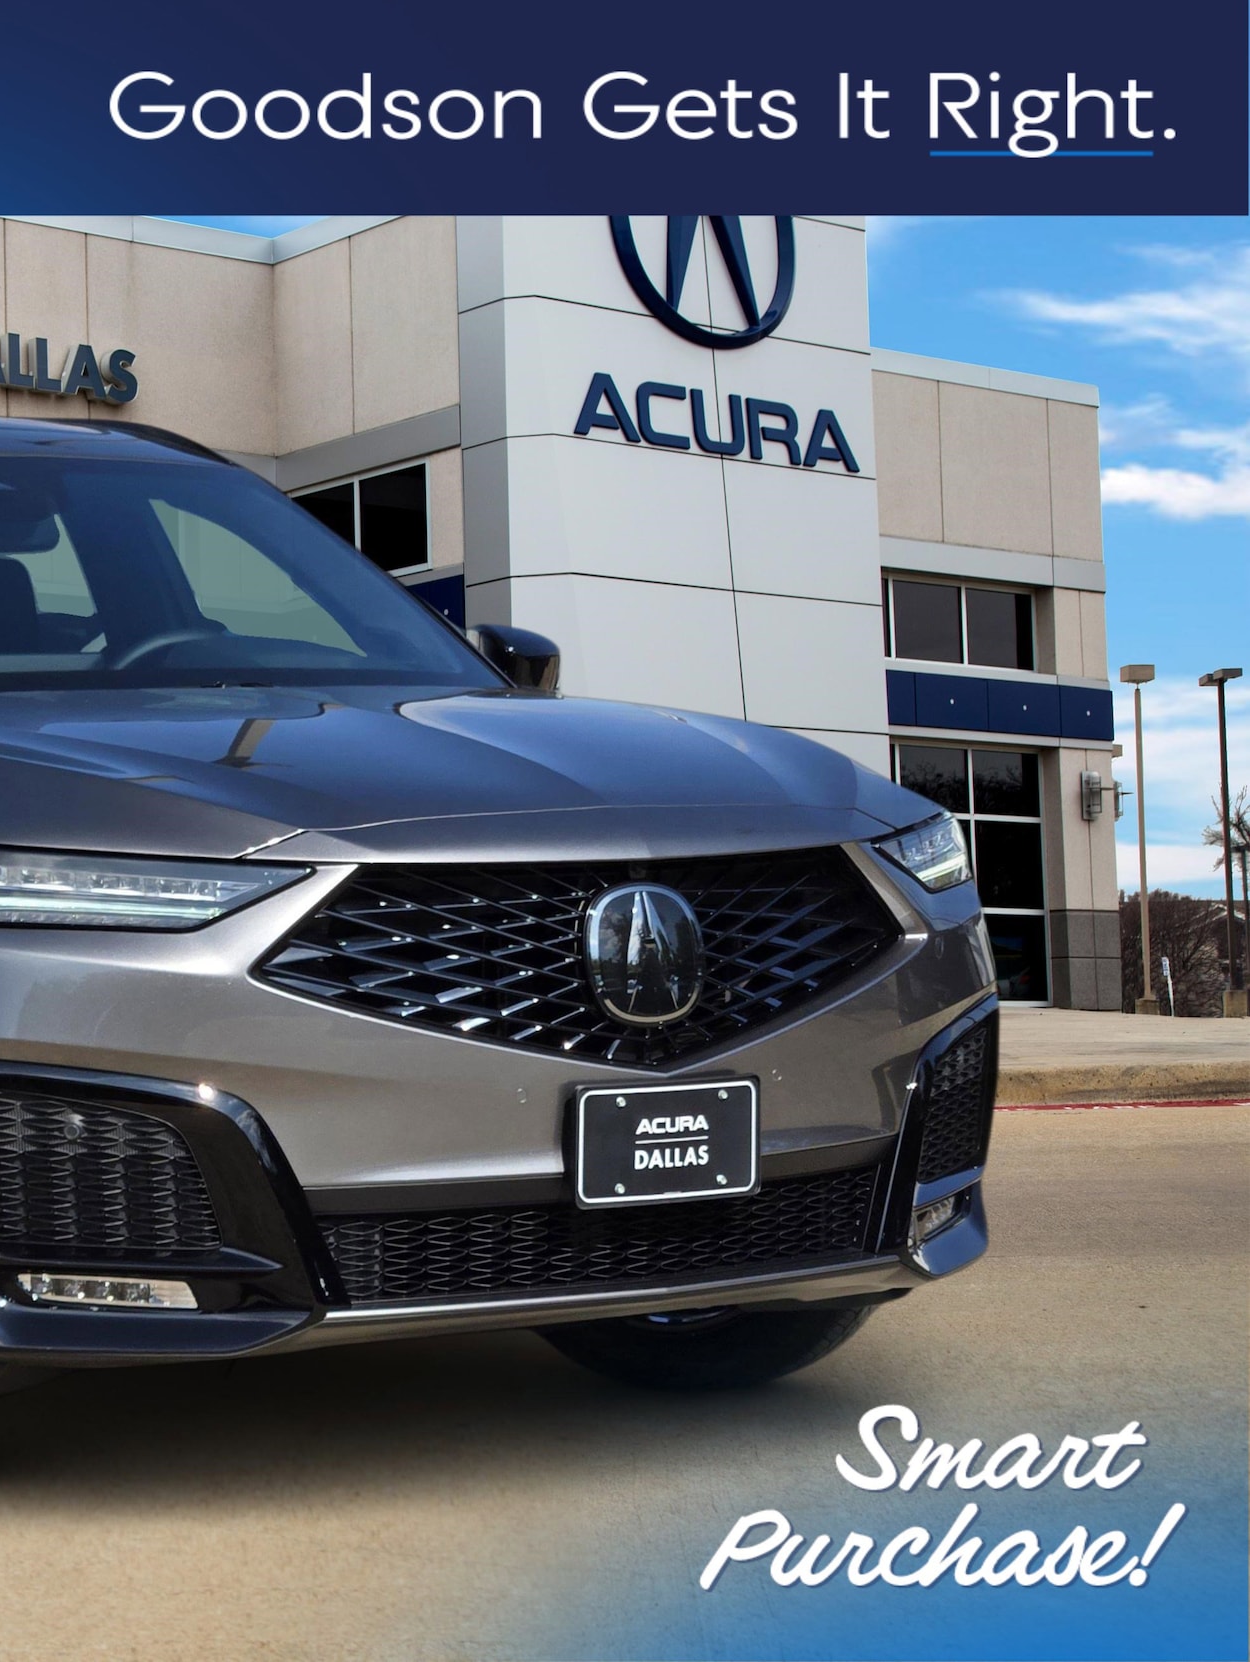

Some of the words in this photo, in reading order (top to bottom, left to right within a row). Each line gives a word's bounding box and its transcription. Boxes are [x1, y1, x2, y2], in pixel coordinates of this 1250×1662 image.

[573, 372, 860, 473] ACURA
[635, 1114, 710, 1135] ACURA
[634, 1145, 710, 1170] DALLAS
